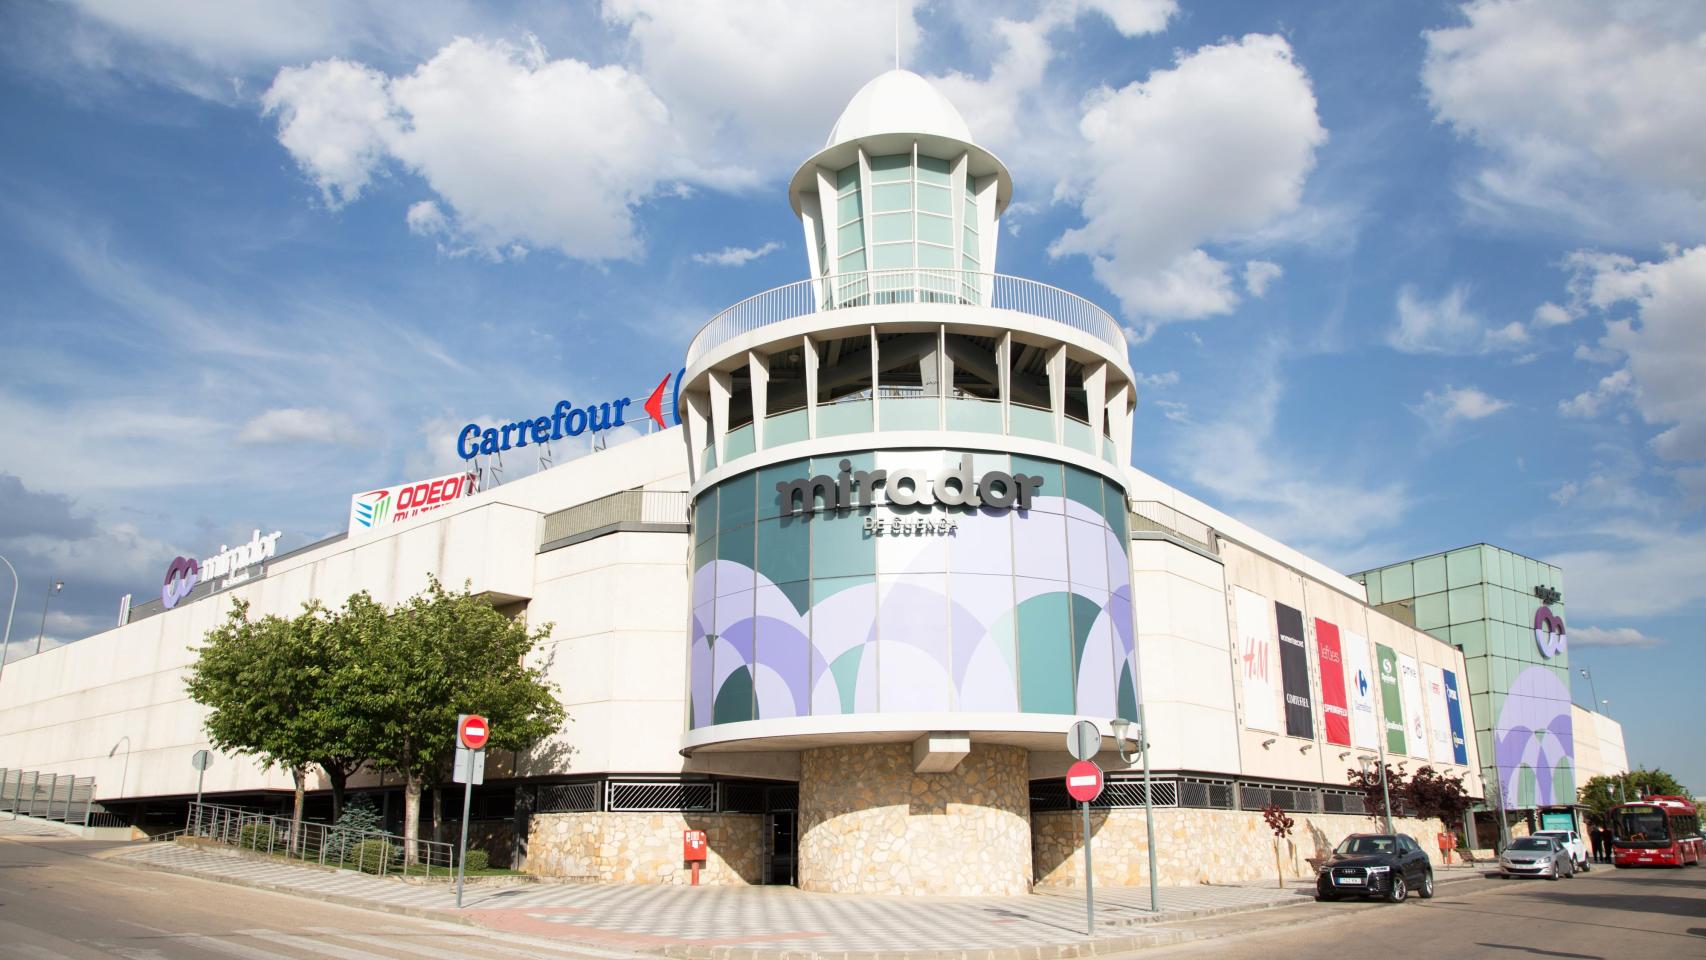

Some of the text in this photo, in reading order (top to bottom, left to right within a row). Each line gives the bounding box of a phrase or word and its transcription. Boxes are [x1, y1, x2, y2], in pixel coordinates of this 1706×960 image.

[457, 397, 631, 460] Carrefour
[776, 454, 1044, 516] mirador
[863, 517, 958, 531] DE CUENCA
[201, 529, 282, 582] mirador
[1243, 635, 1269, 684] H&M
